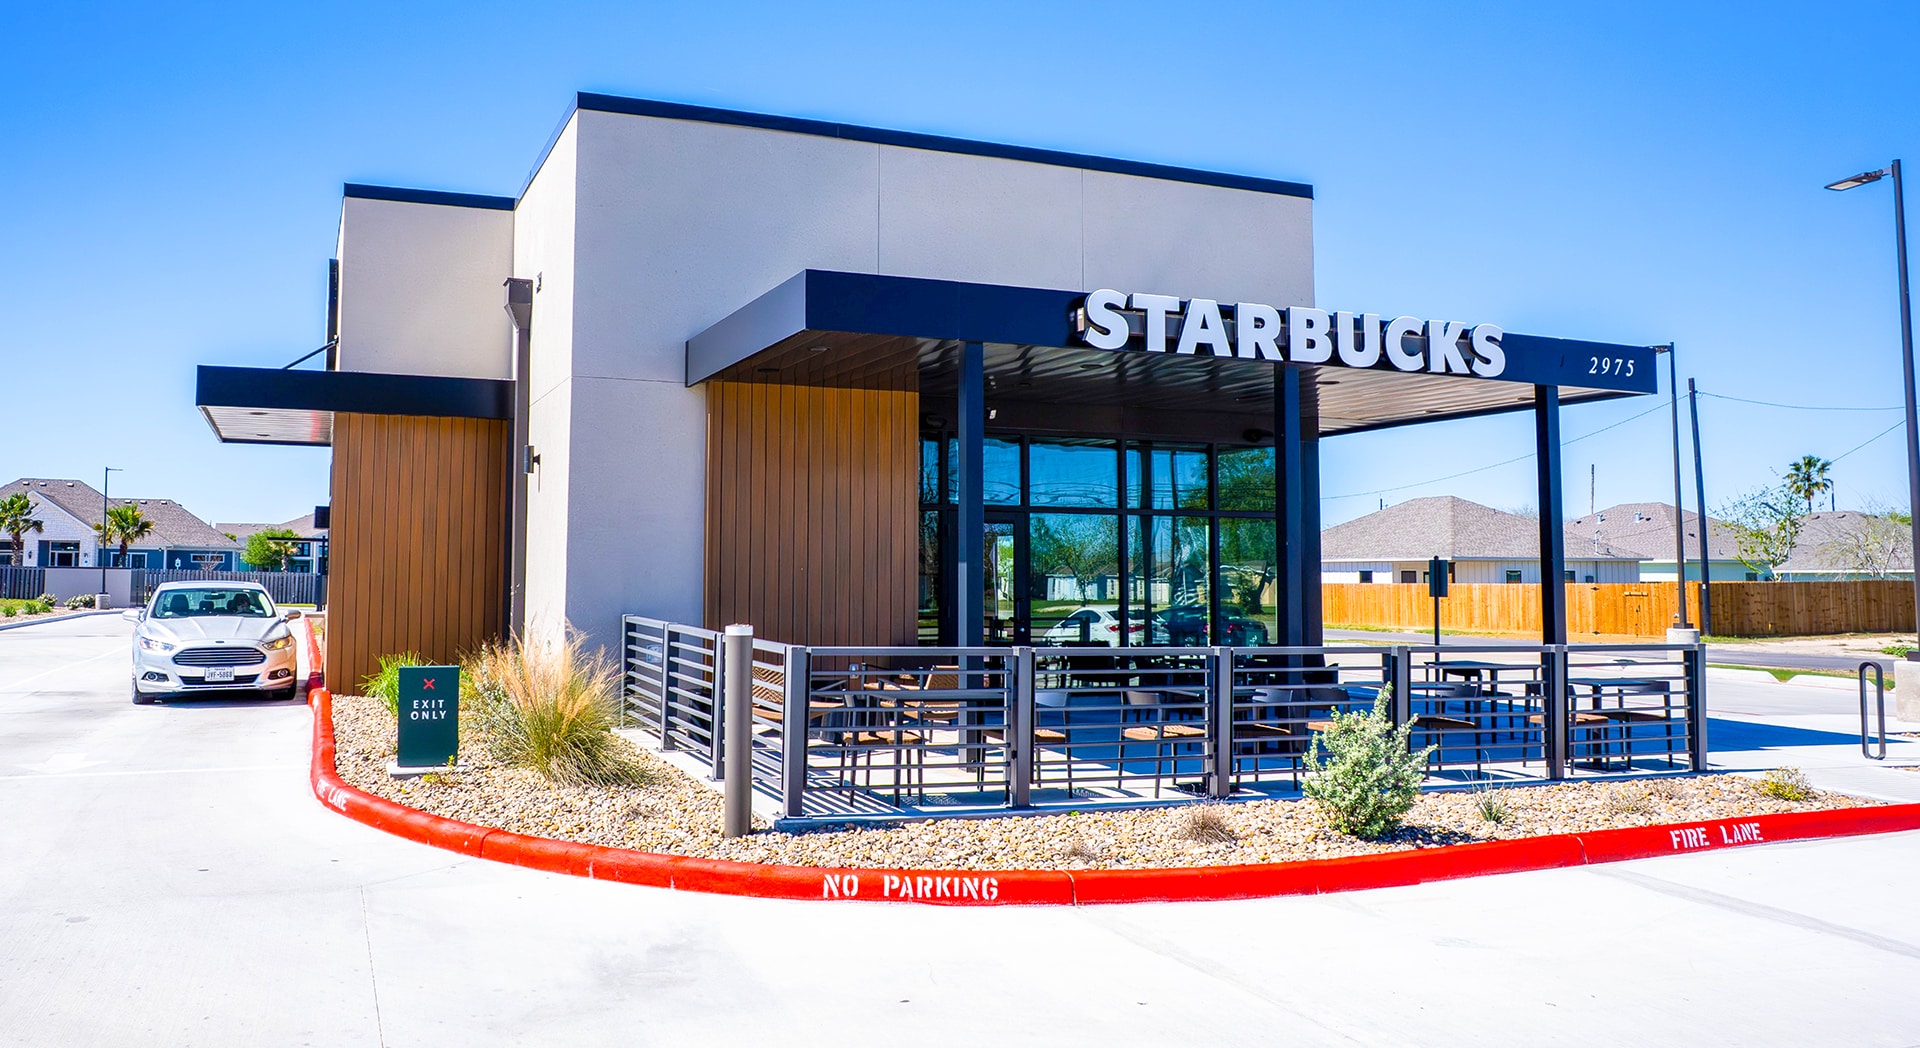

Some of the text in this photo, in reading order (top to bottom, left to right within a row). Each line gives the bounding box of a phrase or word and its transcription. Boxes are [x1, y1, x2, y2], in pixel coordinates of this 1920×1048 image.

[1084, 288, 1506, 378] STARBUCKS
[1588, 356, 1635, 377] 2975
[410, 710, 447, 720] ONLY
[413, 699, 445, 709] EXIT
[327, 786, 351, 812] LANE
[1669, 822, 1764, 850] FIRE LANE
[823, 874, 998, 900] NO PARKING
